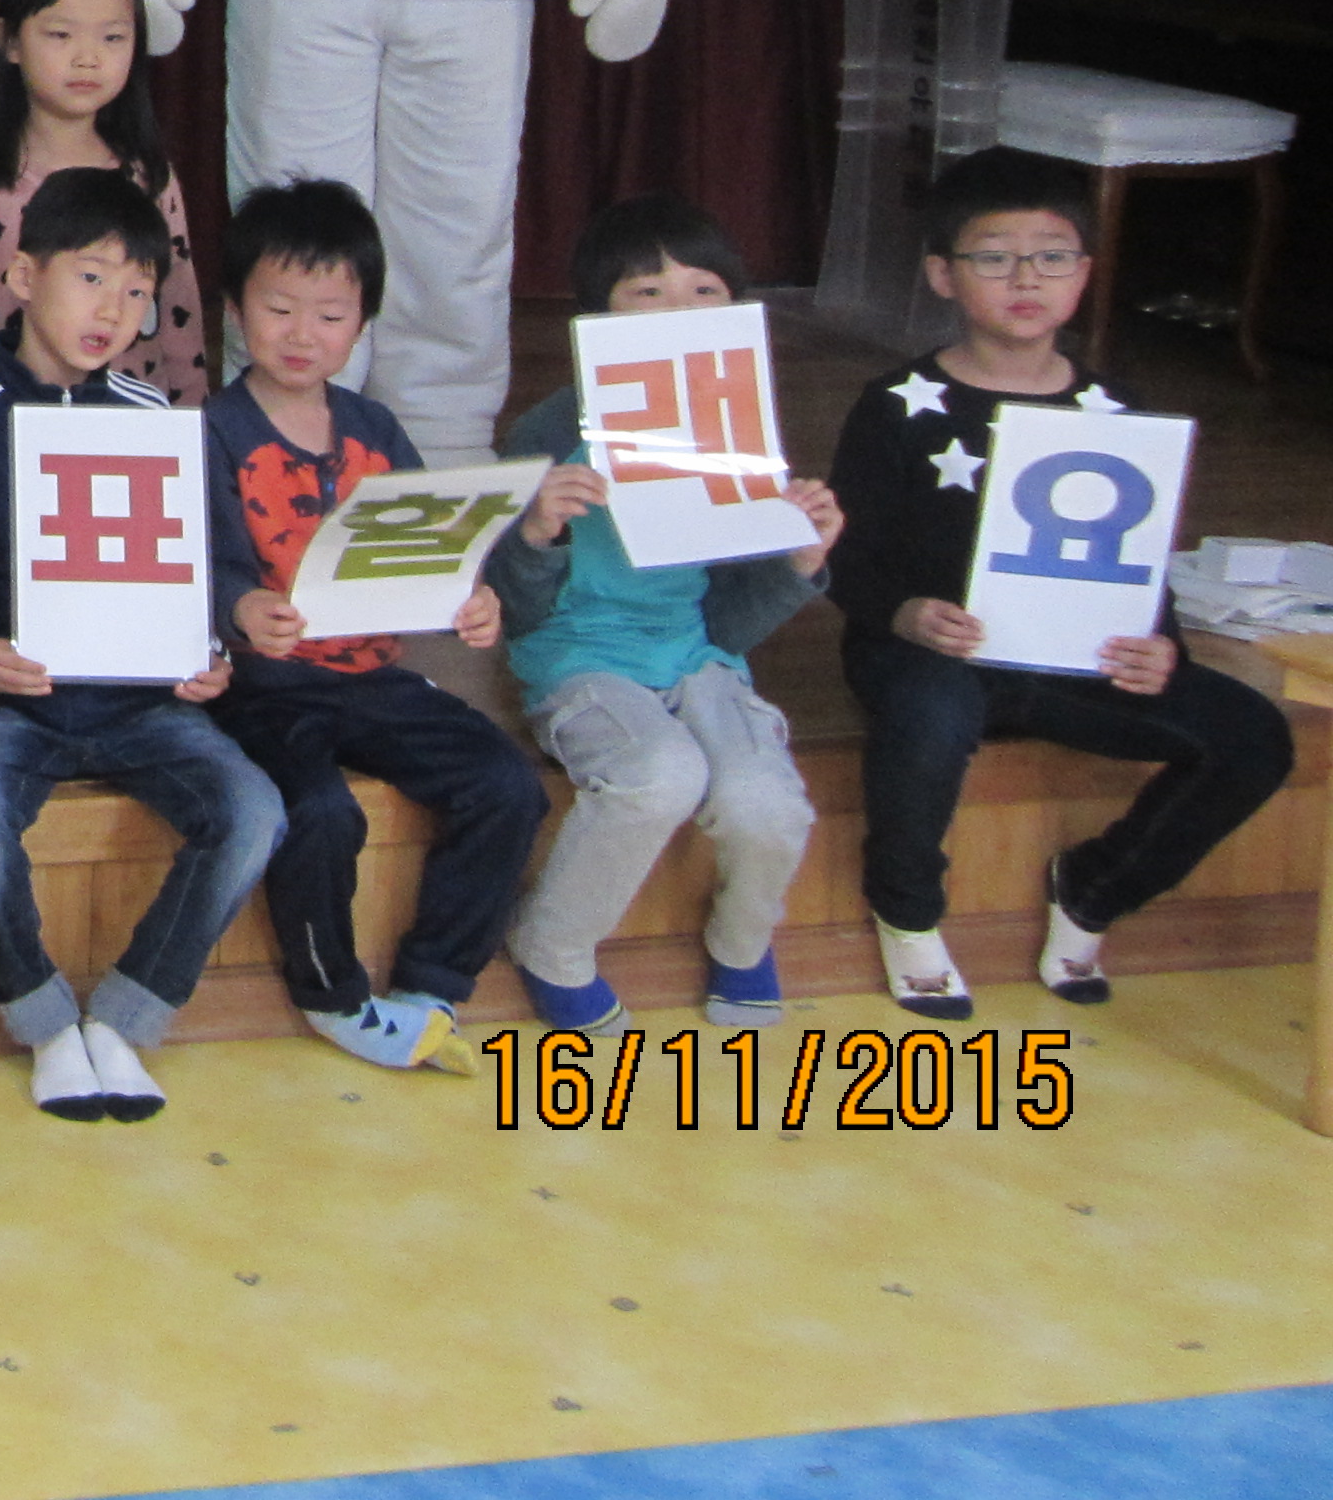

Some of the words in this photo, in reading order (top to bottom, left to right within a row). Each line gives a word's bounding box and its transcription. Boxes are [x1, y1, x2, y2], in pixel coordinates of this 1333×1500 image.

[592, 347, 784, 506] 래
[30, 453, 195, 584] 표
[331, 489, 523, 583] 할
[988, 449, 1155, 585] 요
